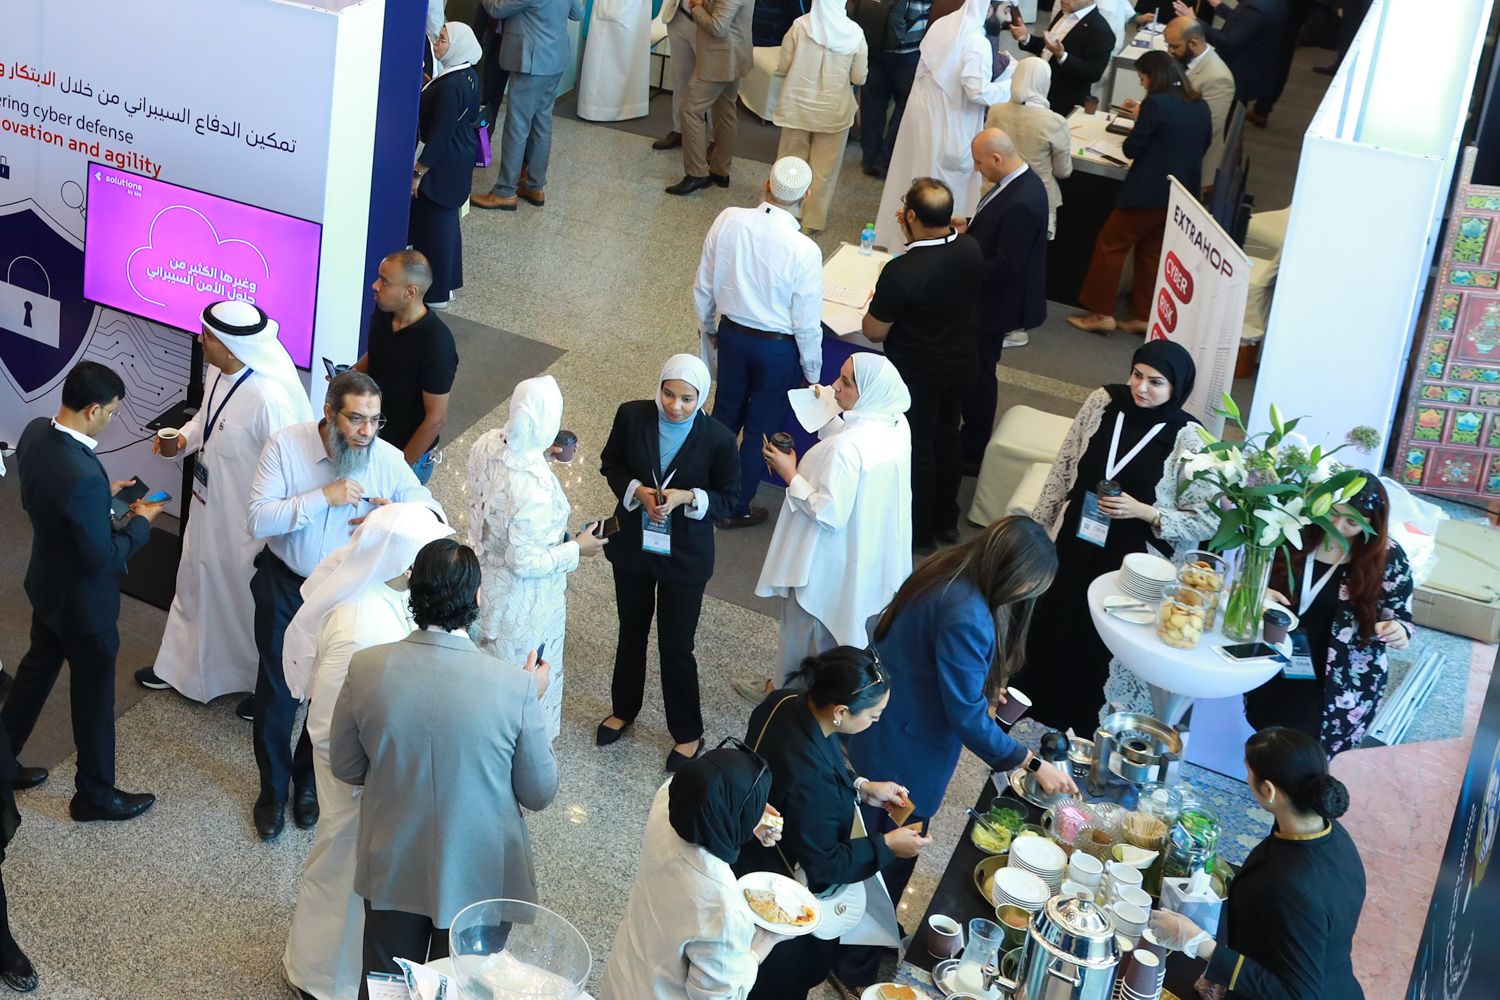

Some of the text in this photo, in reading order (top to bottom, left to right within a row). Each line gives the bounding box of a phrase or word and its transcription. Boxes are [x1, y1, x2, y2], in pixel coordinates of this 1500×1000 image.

[9, 62, 56, 88] الابتكار
[60, 76, 93, 98] خلال
[98, 90, 120, 106] من
[124, 97, 191, 125] السيبراني
[33, 105, 73, 126] cyber
[76, 115, 134, 144] defense
[195, 114, 241, 139] الدفاع
[245, 128, 297, 153] تمكين
[68, 137, 100, 158] and
[104, 147, 162, 179] agility
[105, 174, 143, 191] solutions
[1173, 205, 1234, 278] EXTRAHOP
[146, 266, 194, 287] السيبراني
[169, 257, 257, 293] وغيرها الكثير من
[195, 277, 225, 297] الأمن
[1166, 258, 1188, 295] CYBER
[1159, 294, 1174, 326] RISK
